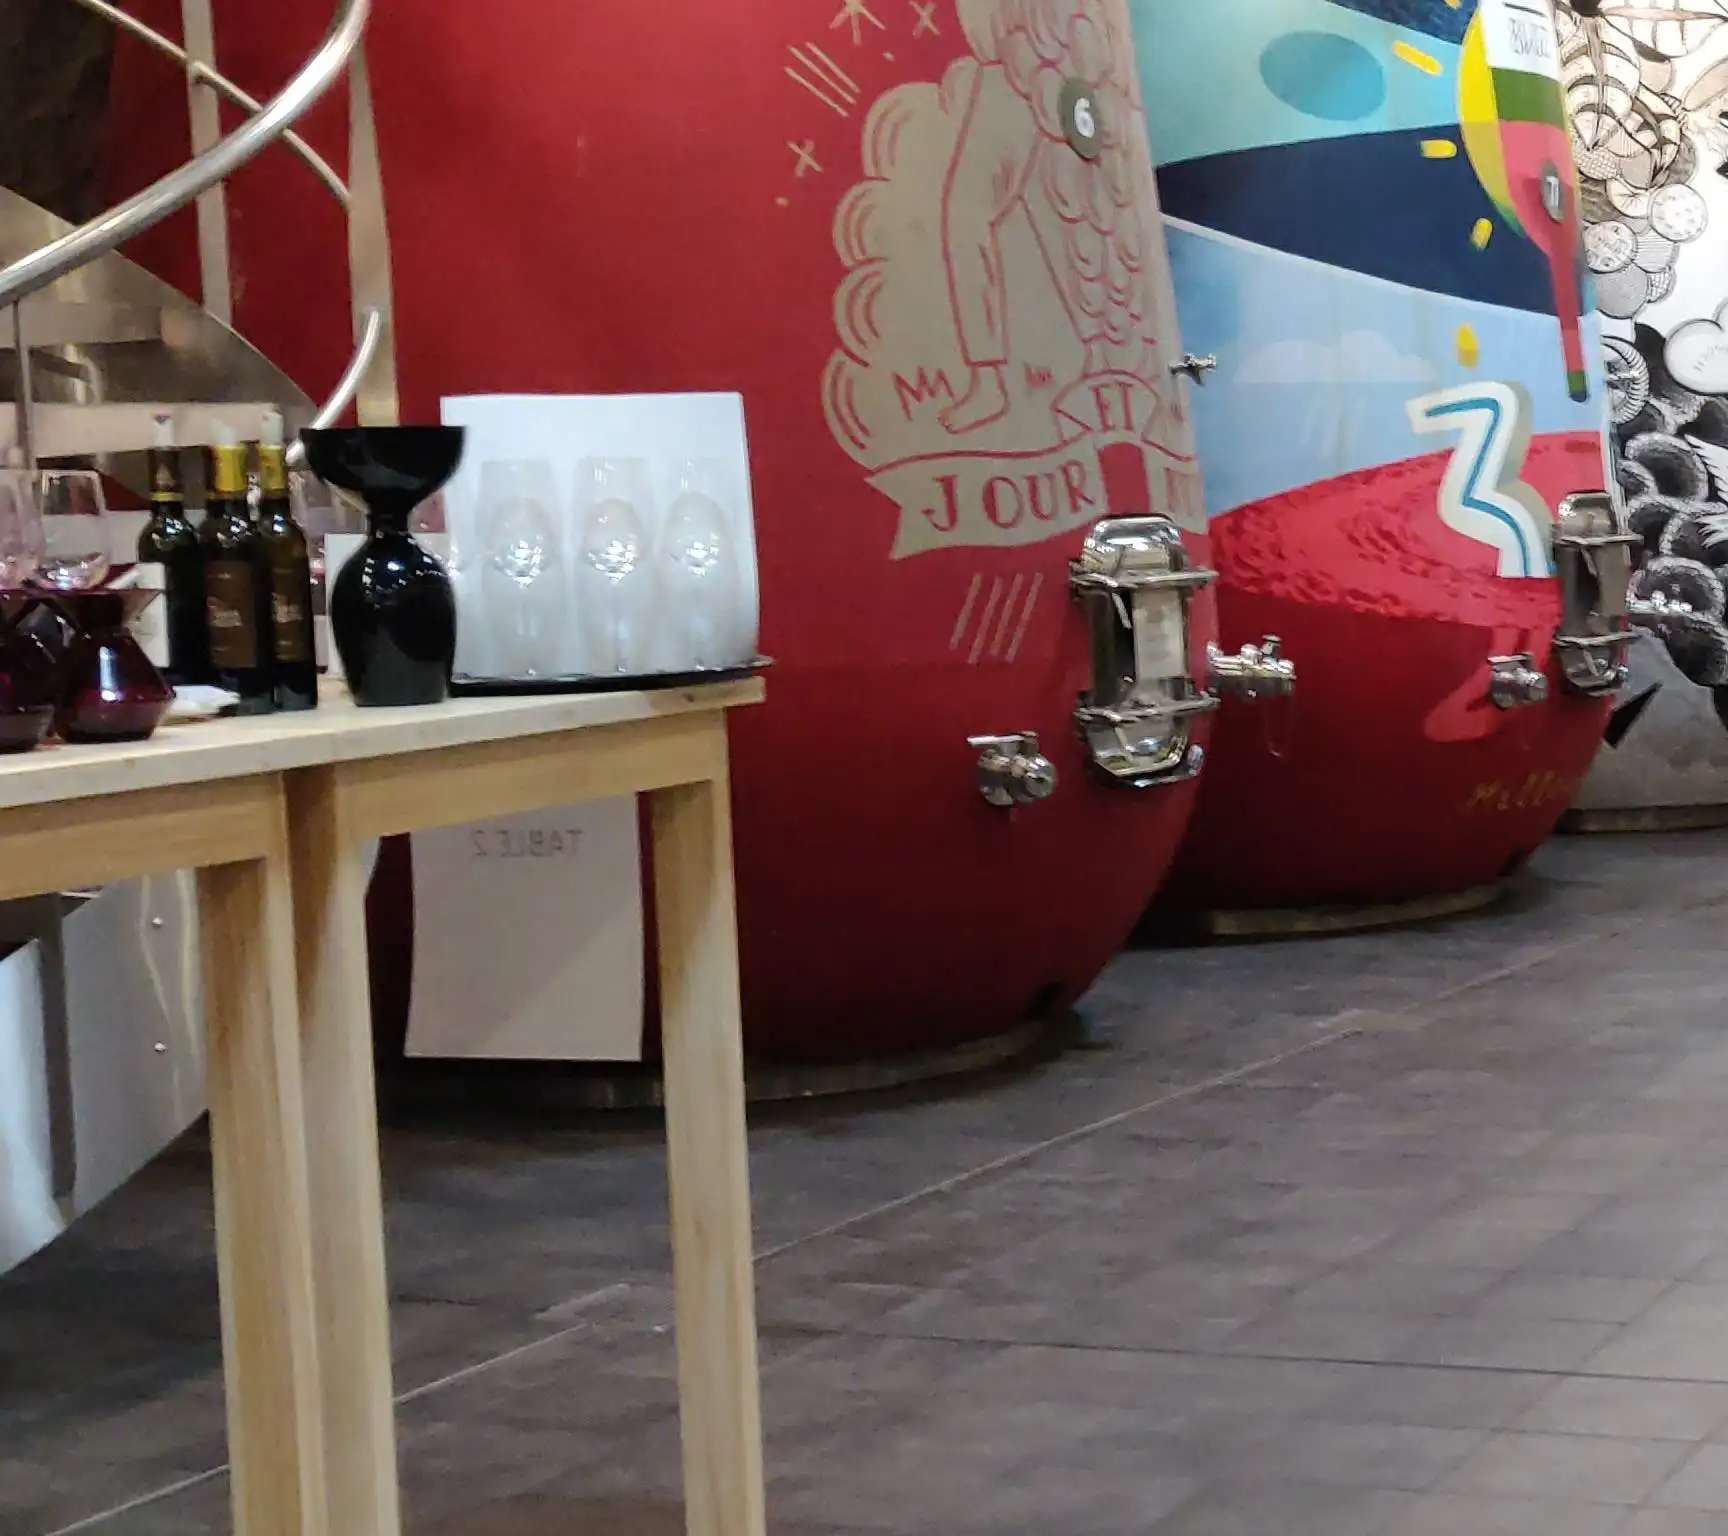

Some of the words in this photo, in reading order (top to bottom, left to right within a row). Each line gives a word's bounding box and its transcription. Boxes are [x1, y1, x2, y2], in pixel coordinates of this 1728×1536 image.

[1073, 97, 1095, 138] 6
[1089, 381, 1135, 432] ET
[921, 459, 1096, 532] JOUR
